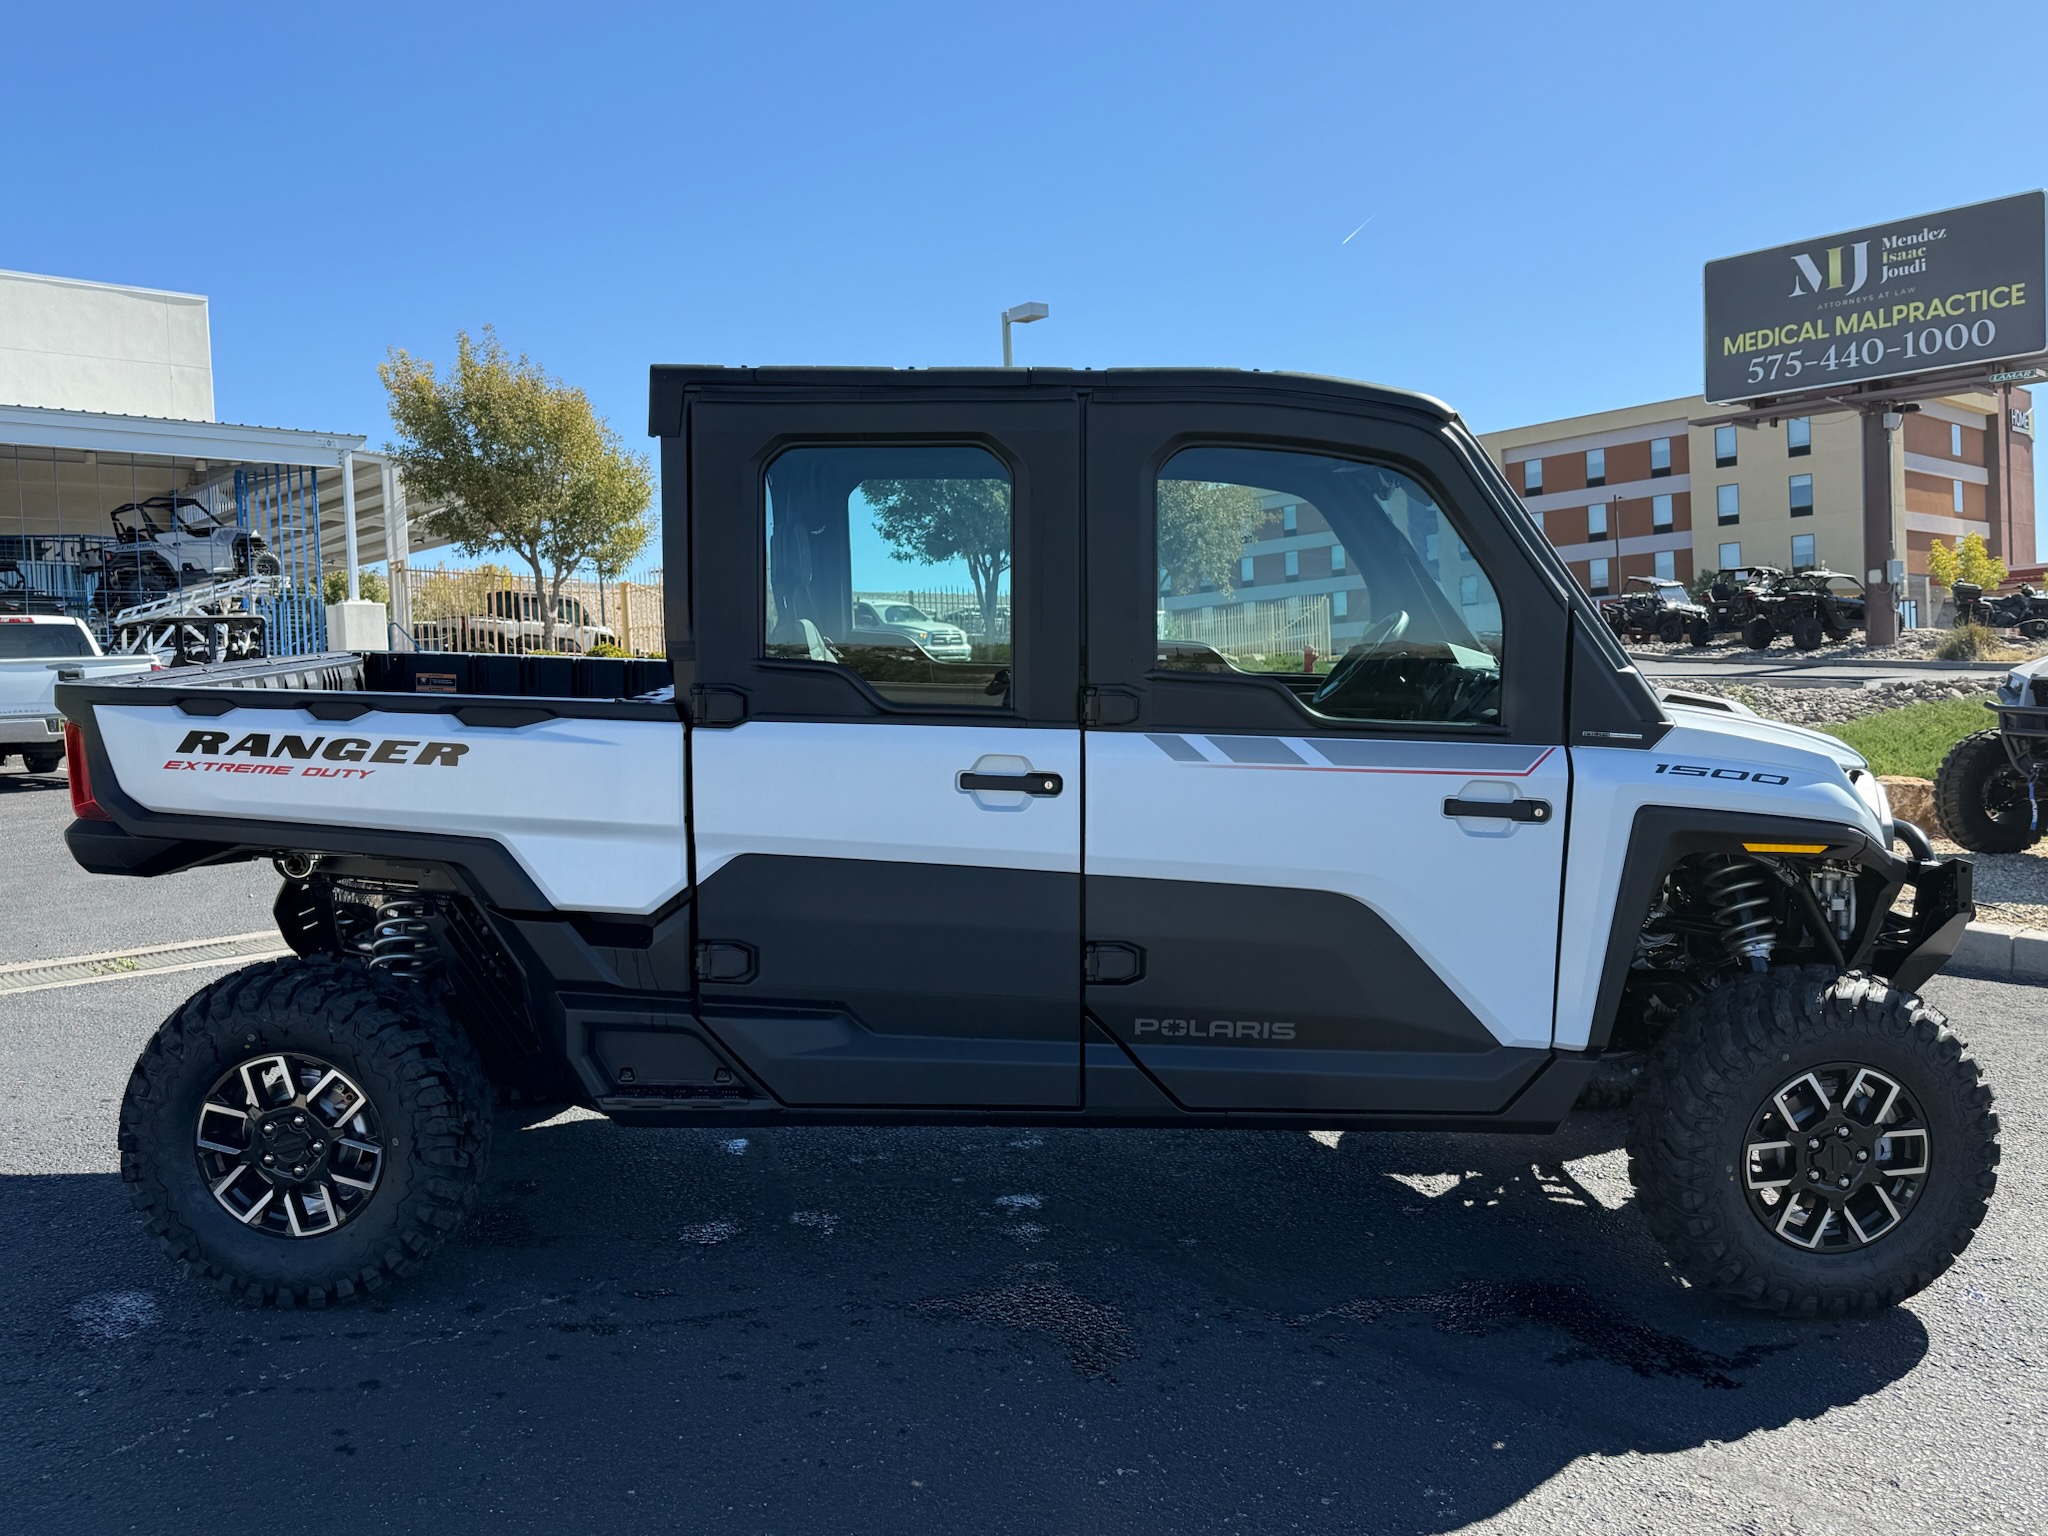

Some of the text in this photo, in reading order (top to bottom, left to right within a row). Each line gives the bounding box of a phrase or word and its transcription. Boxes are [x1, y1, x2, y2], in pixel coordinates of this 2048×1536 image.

[1882, 227, 1947, 250] Mendez
[1882, 246, 1927, 264] Isaac
[1880, 258, 1927, 284] Joudi
[1817, 286, 1917, 311] ATTORNEYS AT LAW
[1723, 282, 2026, 356] MEDICAL MALPRACTICE
[1747, 318, 1996, 384] 575-440-1000
[1993, 370, 2032, 381] LAMAR
[2012, 408, 2030, 430] HOME
[175, 730, 471, 767] RANGER
[162, 760, 377, 780] EXTREME DUTY
[1655, 763, 1790, 786] 1500
[1134, 1018, 1297, 1040] POLARIS
